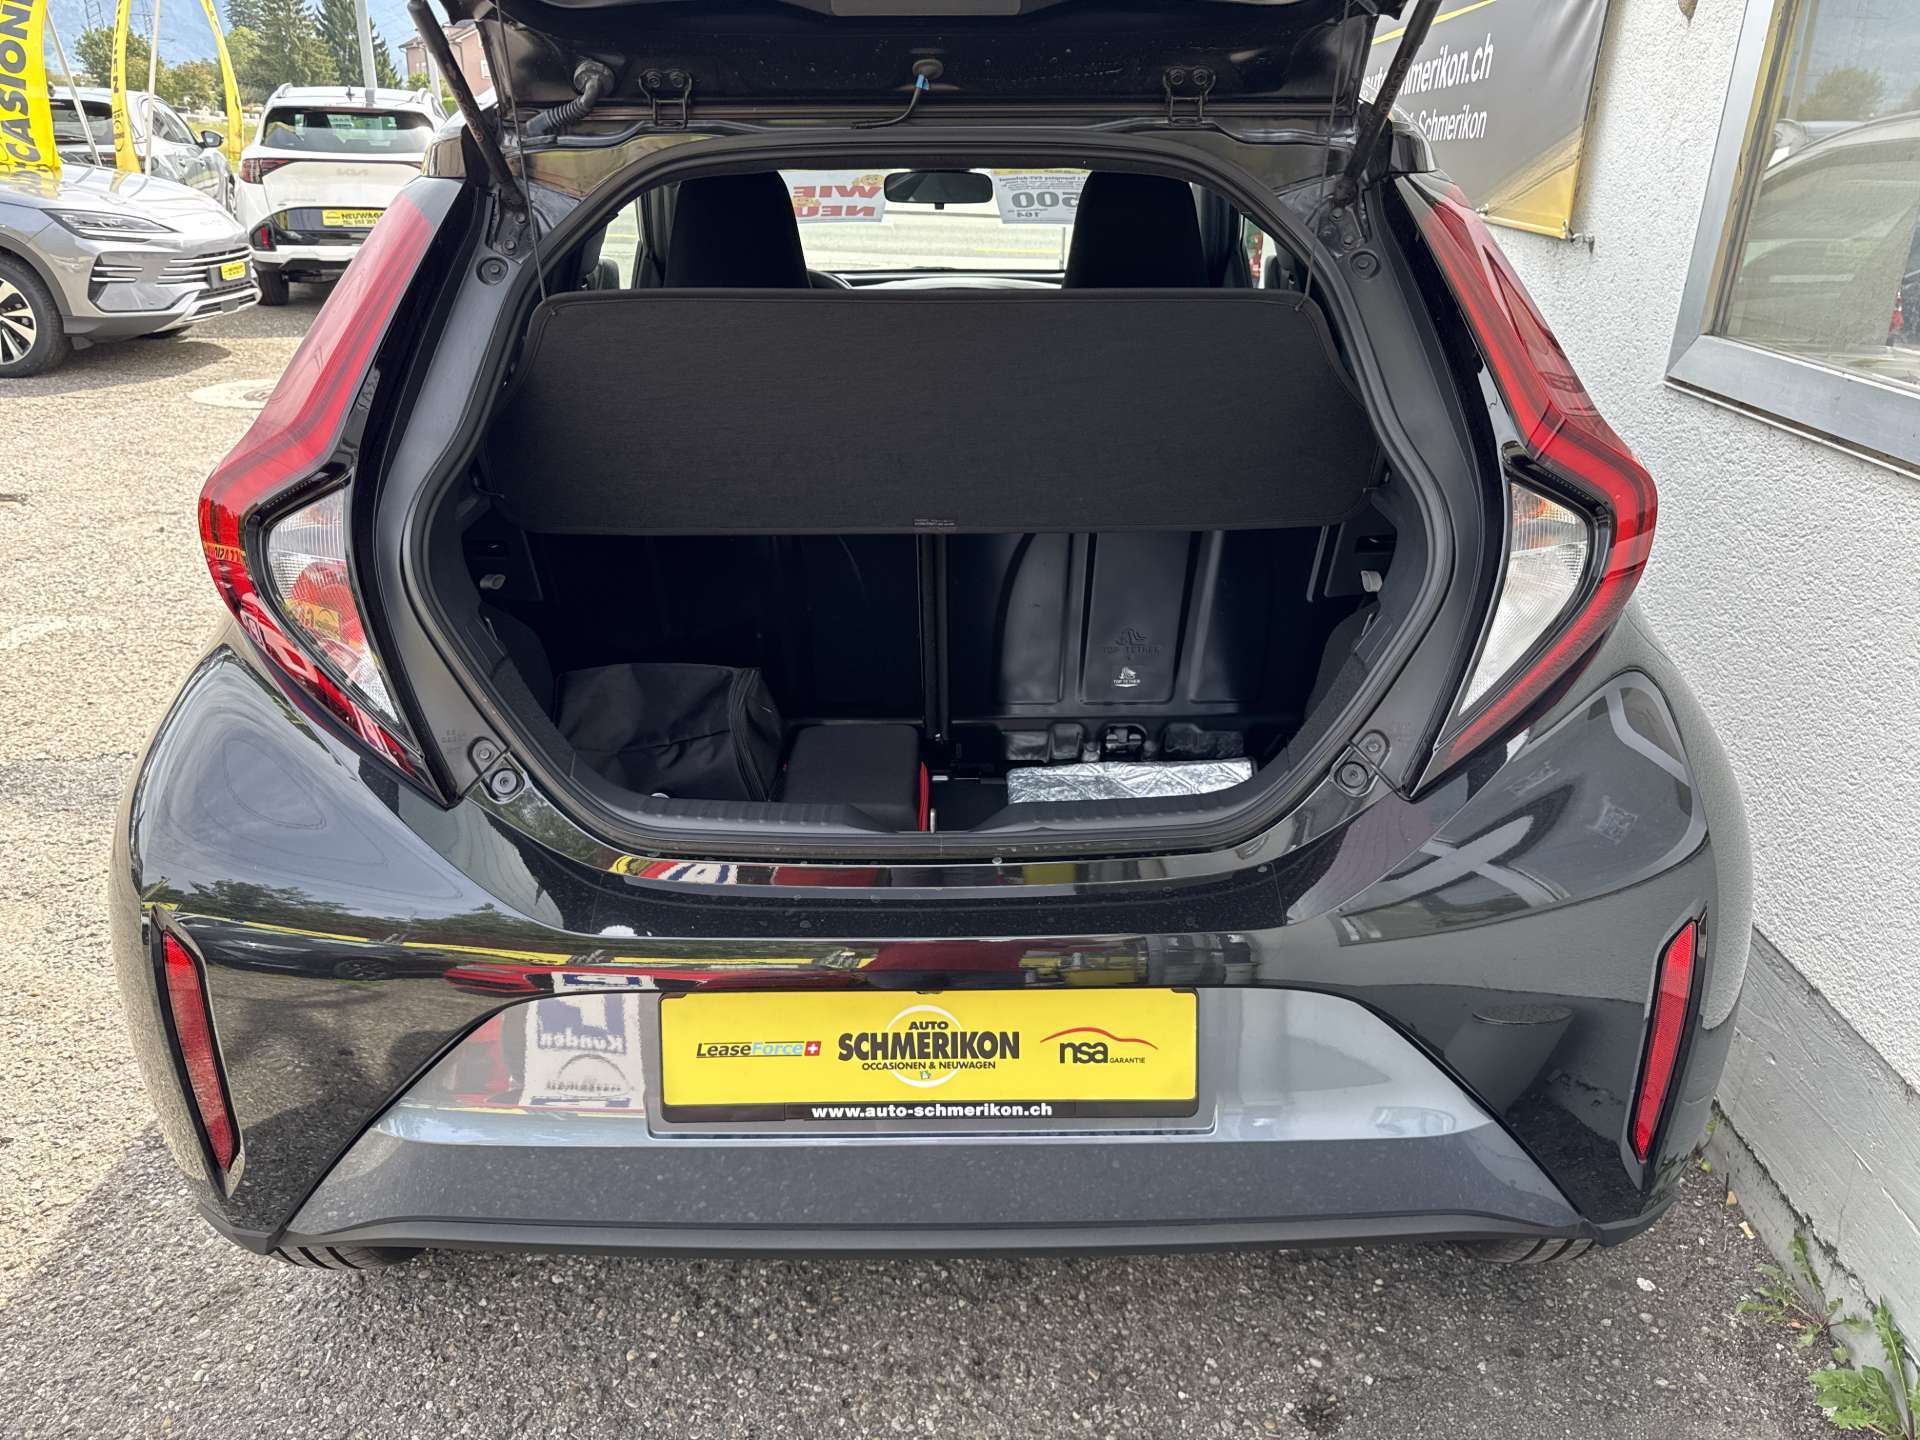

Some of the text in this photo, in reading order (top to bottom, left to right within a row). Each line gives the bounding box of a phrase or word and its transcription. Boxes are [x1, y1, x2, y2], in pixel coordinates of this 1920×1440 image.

[0, 0, 41, 163] CASION
[1418, 104, 1488, 142] Schmerikon
[909, 1021, 949, 1031] AUTO
[696, 1042, 804, 1057] LeaseForce
[838, 1031, 1020, 1061] SCHMERIKON
[1059, 1042, 1109, 1064] nsa
[861, 1060, 996, 1071] OCCASIONEN & NEUWAGEN
[811, 1103, 1054, 1119] www.auto-schmerikon.ch
